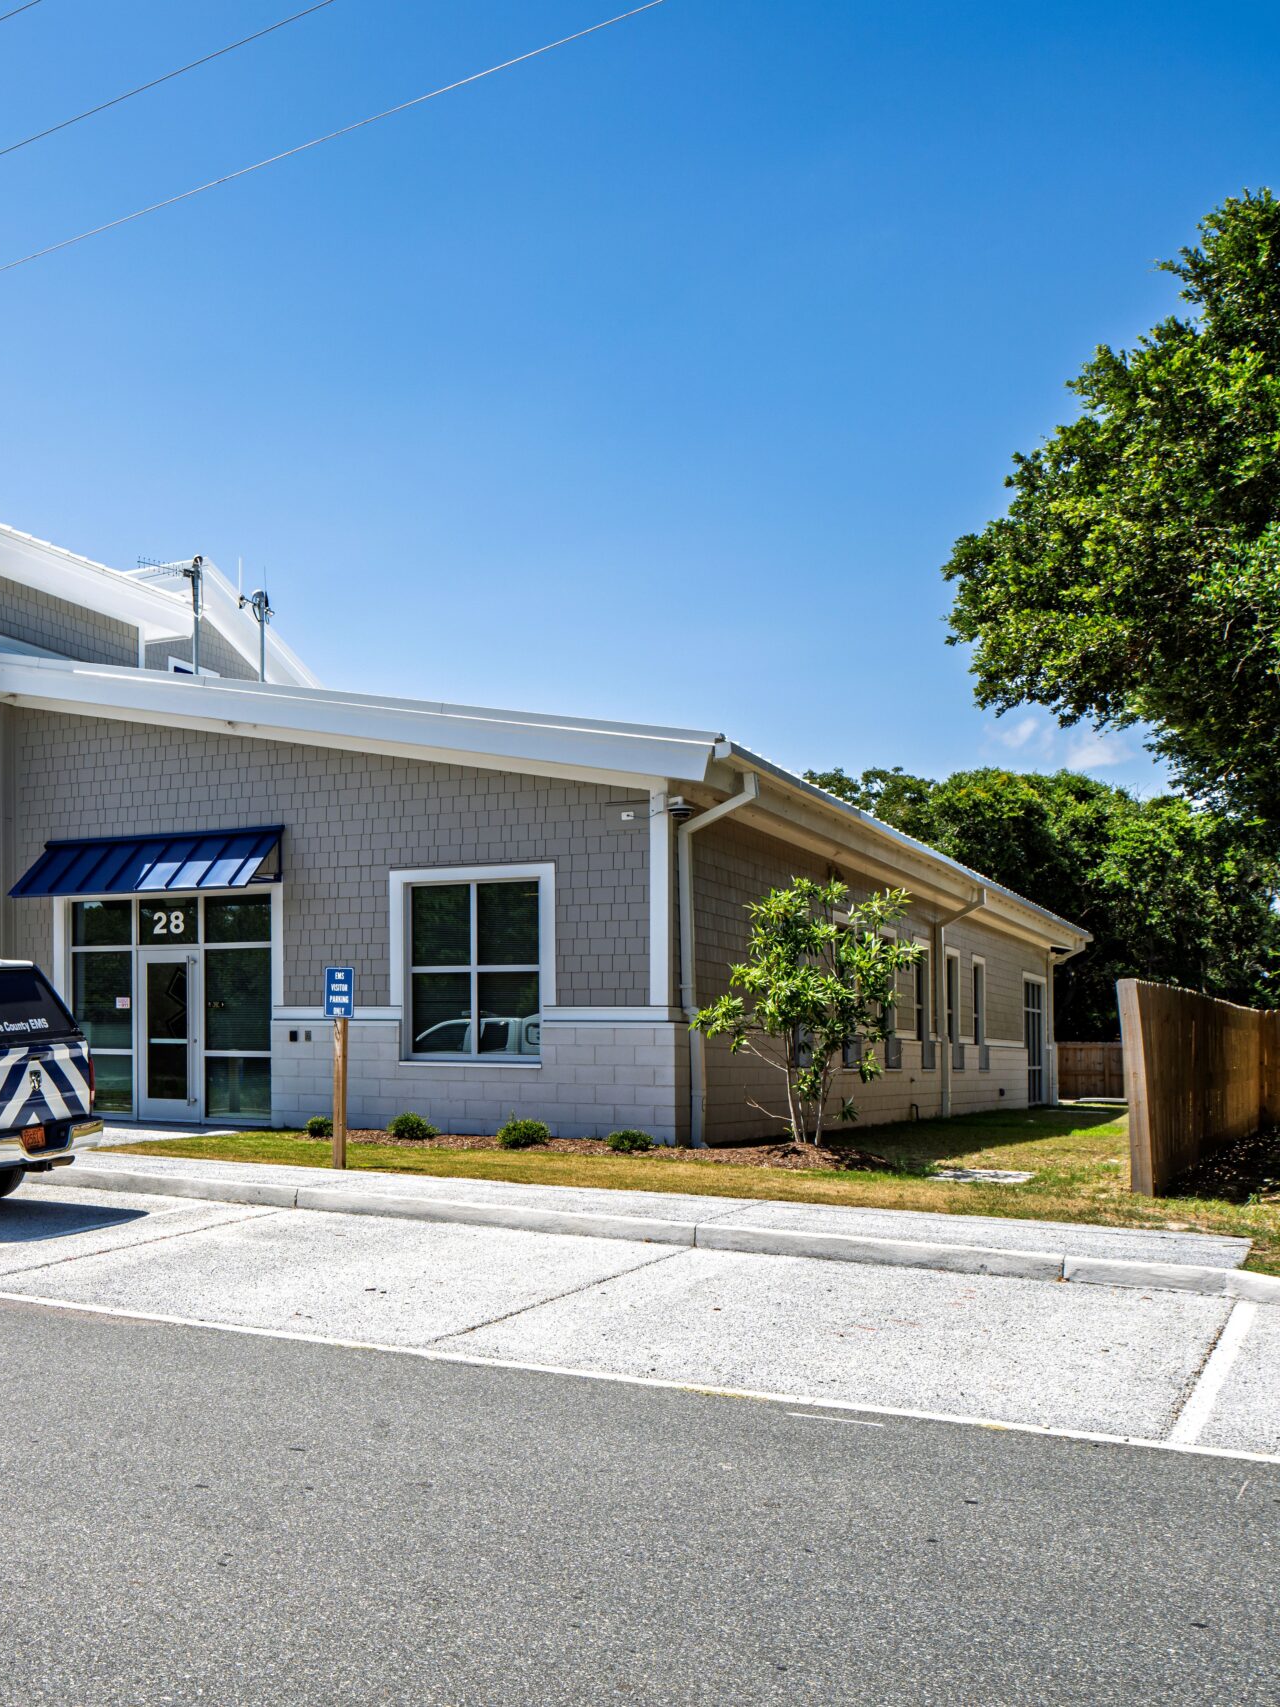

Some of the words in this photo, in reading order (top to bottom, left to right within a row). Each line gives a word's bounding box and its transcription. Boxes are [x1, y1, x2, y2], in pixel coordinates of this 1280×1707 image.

[153, 911, 185, 934] 28
[335, 971, 345, 980] EMS
[330, 983, 348, 992] VISITOR
[329, 995, 349, 1003] PARKING
[333, 1007, 345, 1015] ONLY
[3, 1021, 30, 1032] County
[29, 1017, 49, 1029] EMS
